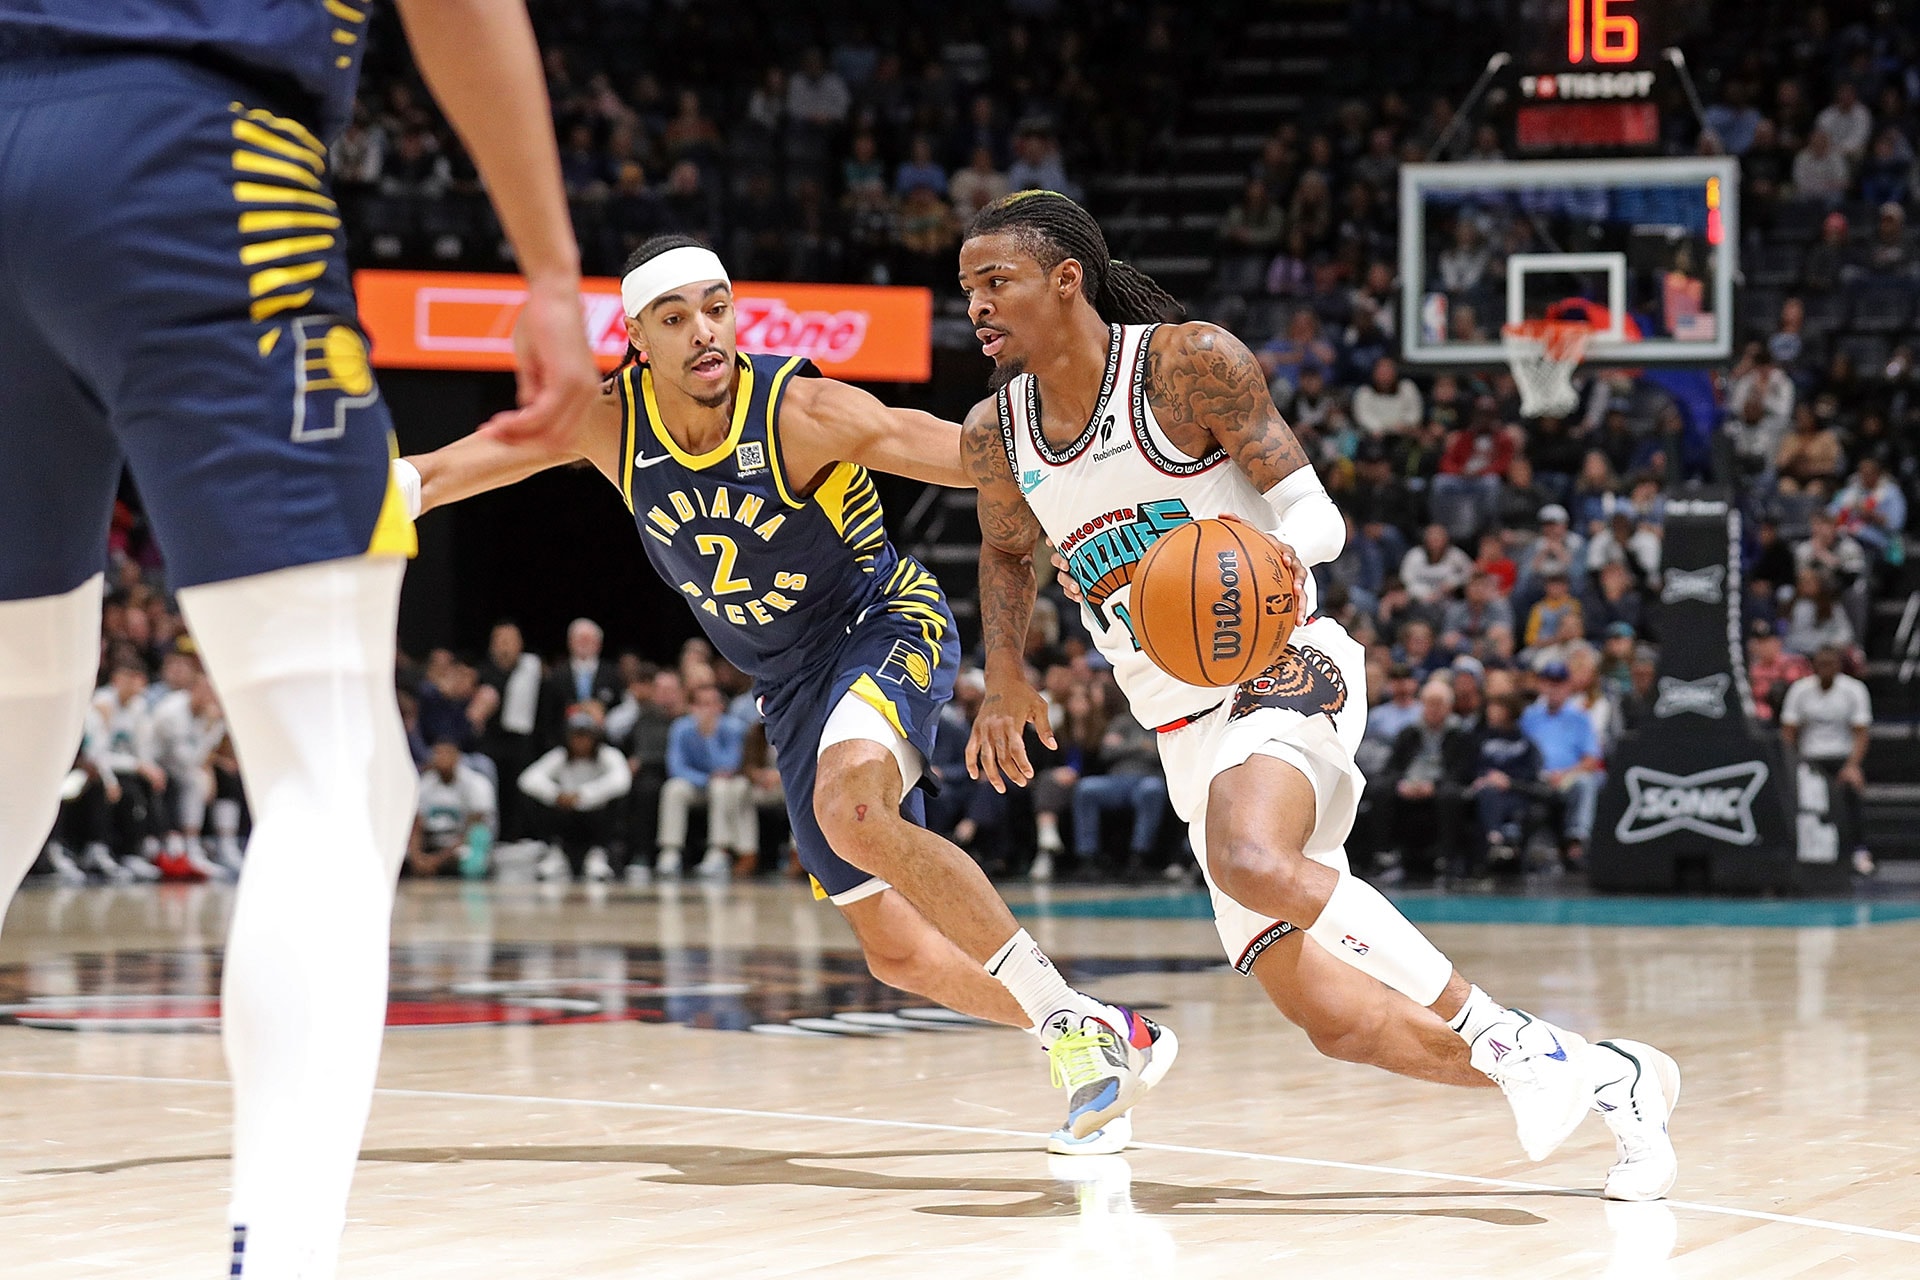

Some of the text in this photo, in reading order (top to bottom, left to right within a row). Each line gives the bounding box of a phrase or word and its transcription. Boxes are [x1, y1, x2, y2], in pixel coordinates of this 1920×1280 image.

[1569, 0, 1639, 64] 16
[1023, 469, 1041, 484] NIKE
[1092, 441, 1133, 463] Robinhood
[645, 486, 787, 547] INDIANA
[1061, 508, 1136, 552] VANCOUVER
[694, 534, 752, 595] 2
[679, 571, 808, 626] PACERS
[1212, 549, 1242, 662] Wilson
